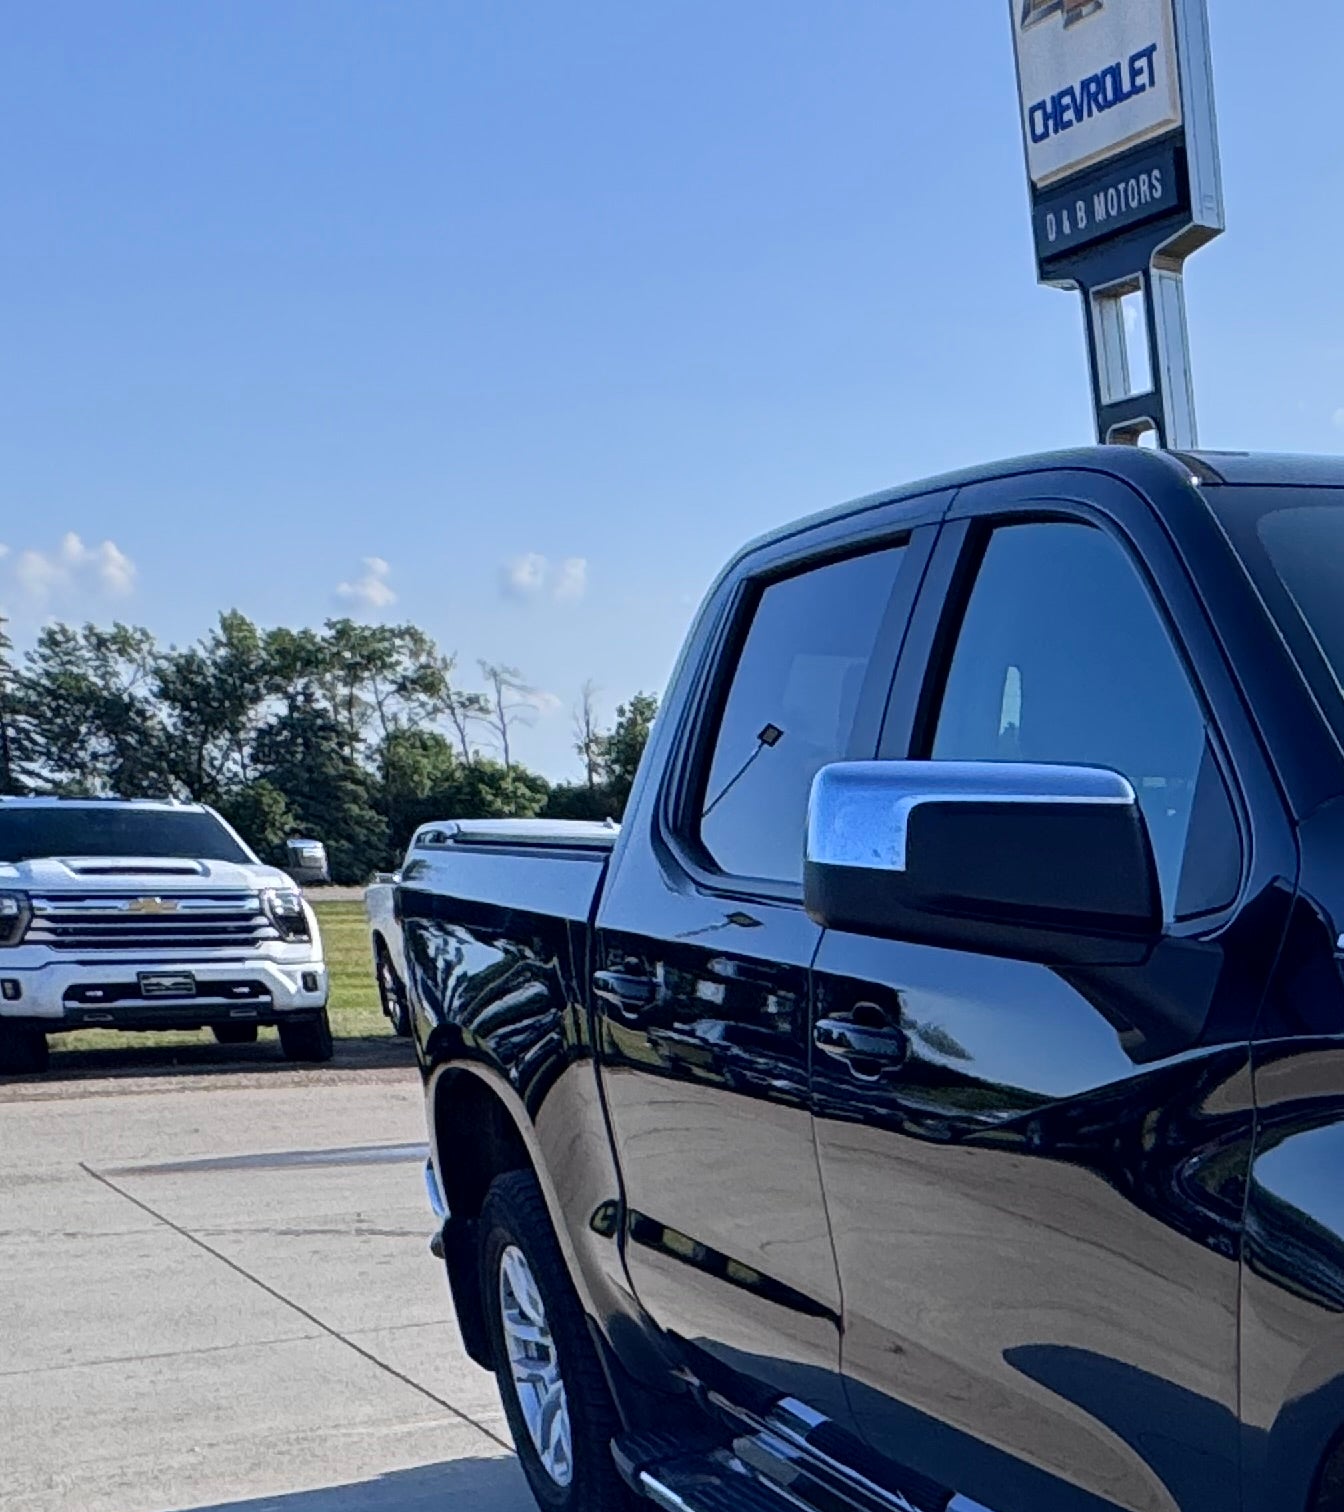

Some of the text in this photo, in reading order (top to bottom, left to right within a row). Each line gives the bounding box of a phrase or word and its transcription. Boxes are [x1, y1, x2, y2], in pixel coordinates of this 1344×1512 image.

[1029, 43, 1157, 143] CHEVROLET
[1046, 168, 1162, 242] D & B MOTORS
